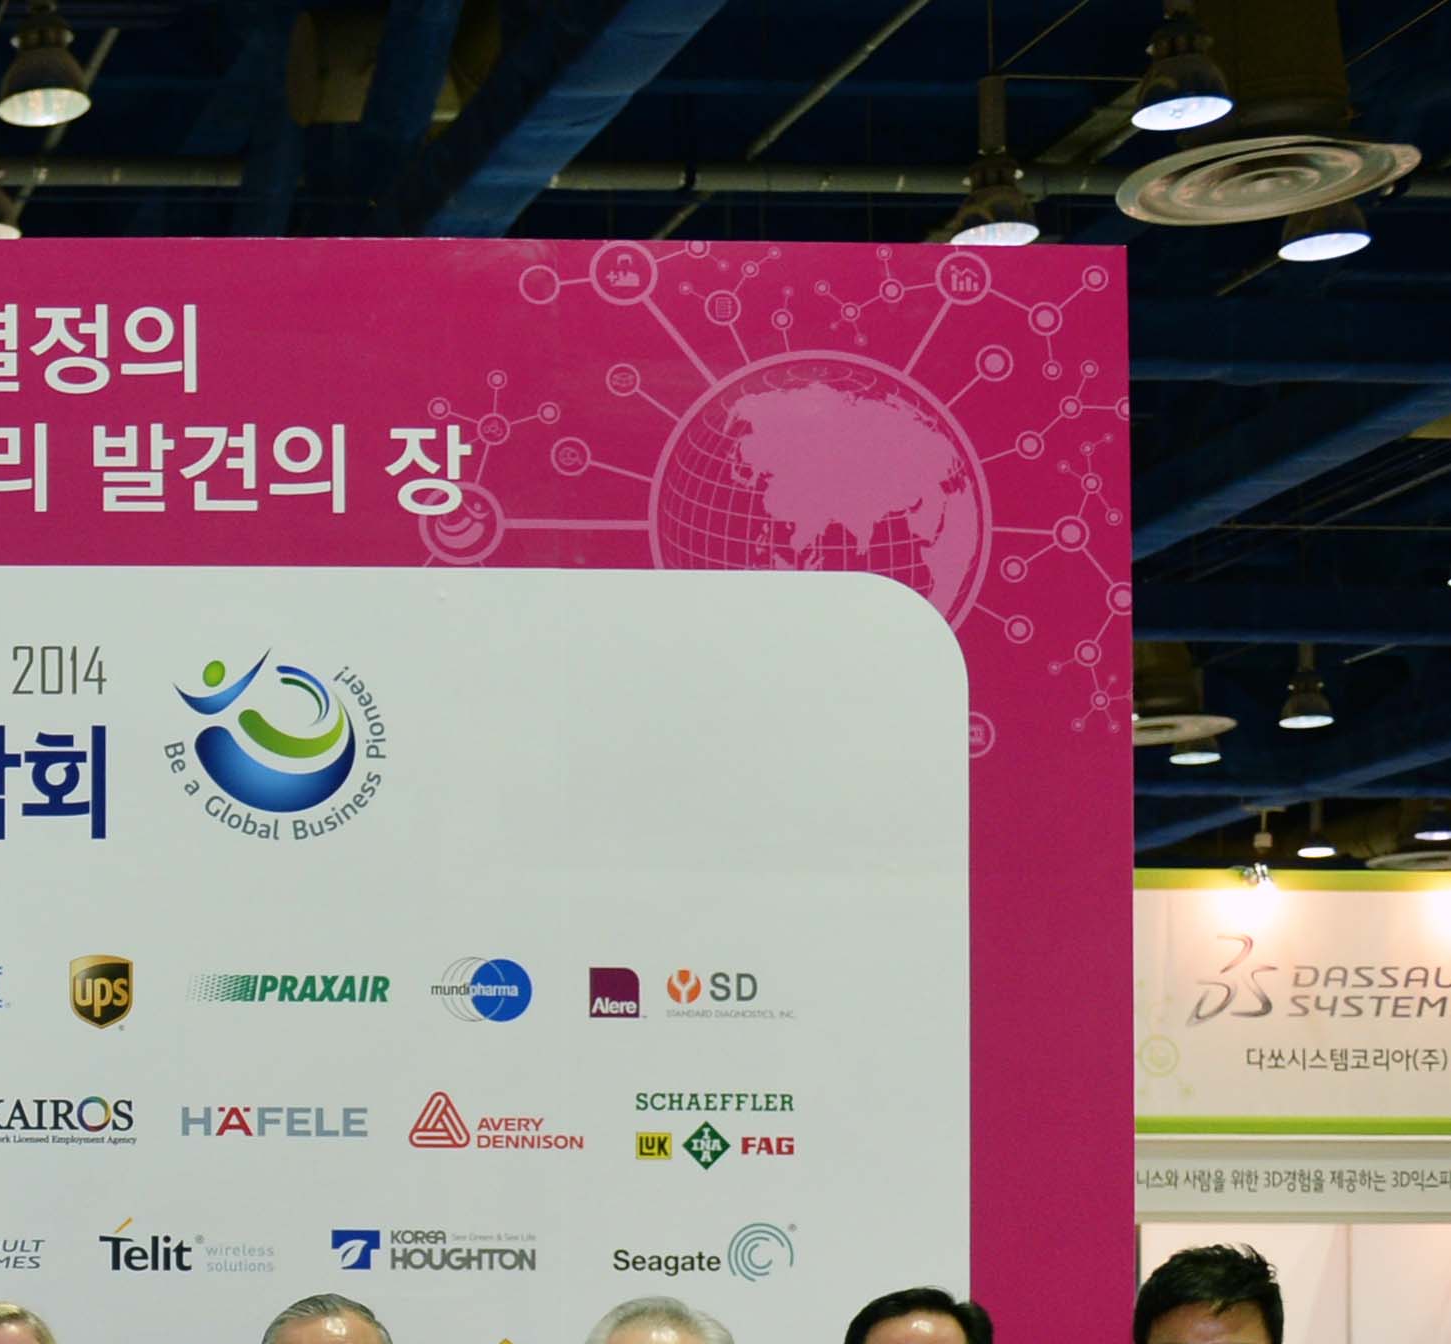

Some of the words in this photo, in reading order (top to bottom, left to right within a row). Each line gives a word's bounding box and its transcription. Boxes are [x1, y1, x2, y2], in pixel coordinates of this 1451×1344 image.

[92, 423, 346, 514] 발견의
[384, 424, 474, 516] 장
[12, 645, 107, 695] 2014
[332, 666, 386, 760] Pioneer!
[163, 741, 186, 774] Be
[184, 779, 201, 796] a
[205, 794, 280, 841] Global
[292, 770, 381, 841] Business
[257, 974, 390, 1003] PRAXAIR
[430, 978, 520, 1000] mundipharma
[709, 971, 758, 1002] SD
[591, 997, 638, 1015] Alere
[666, 1009, 713, 1019] STANDARD
[1246, 1047, 1448, 1072] 다쏘시스템코리아(주)
[635, 1092, 794, 1112] SCHAEFFLER
[181, 1106, 368, 1137] HÄFELE
[477, 1117, 545, 1133] AVERY
[12, 1135, 50, 1144] Licensed
[51, 1133, 105, 1145] Employment
[105, 1133, 138, 1145] Agency
[476, 1134, 584, 1150] DENNISON
[741, 1136, 795, 1156] FAG
[1183, 1169, 1226, 1194] 사람을
[1231, 1169, 1260, 1193] 위한
[1264, 1168, 1326, 1193] 3D경험을
[1329, 1169, 1387, 1194] 제공하는
[390, 1229, 447, 1246] KOREA
[98, 1235, 193, 1272] Telit
[204, 1242, 275, 1258] wireless
[390, 1247, 536, 1271] HOUGHTON
[206, 1257, 275, 1273] solutions
[612, 1249, 722, 1277] Seagate
